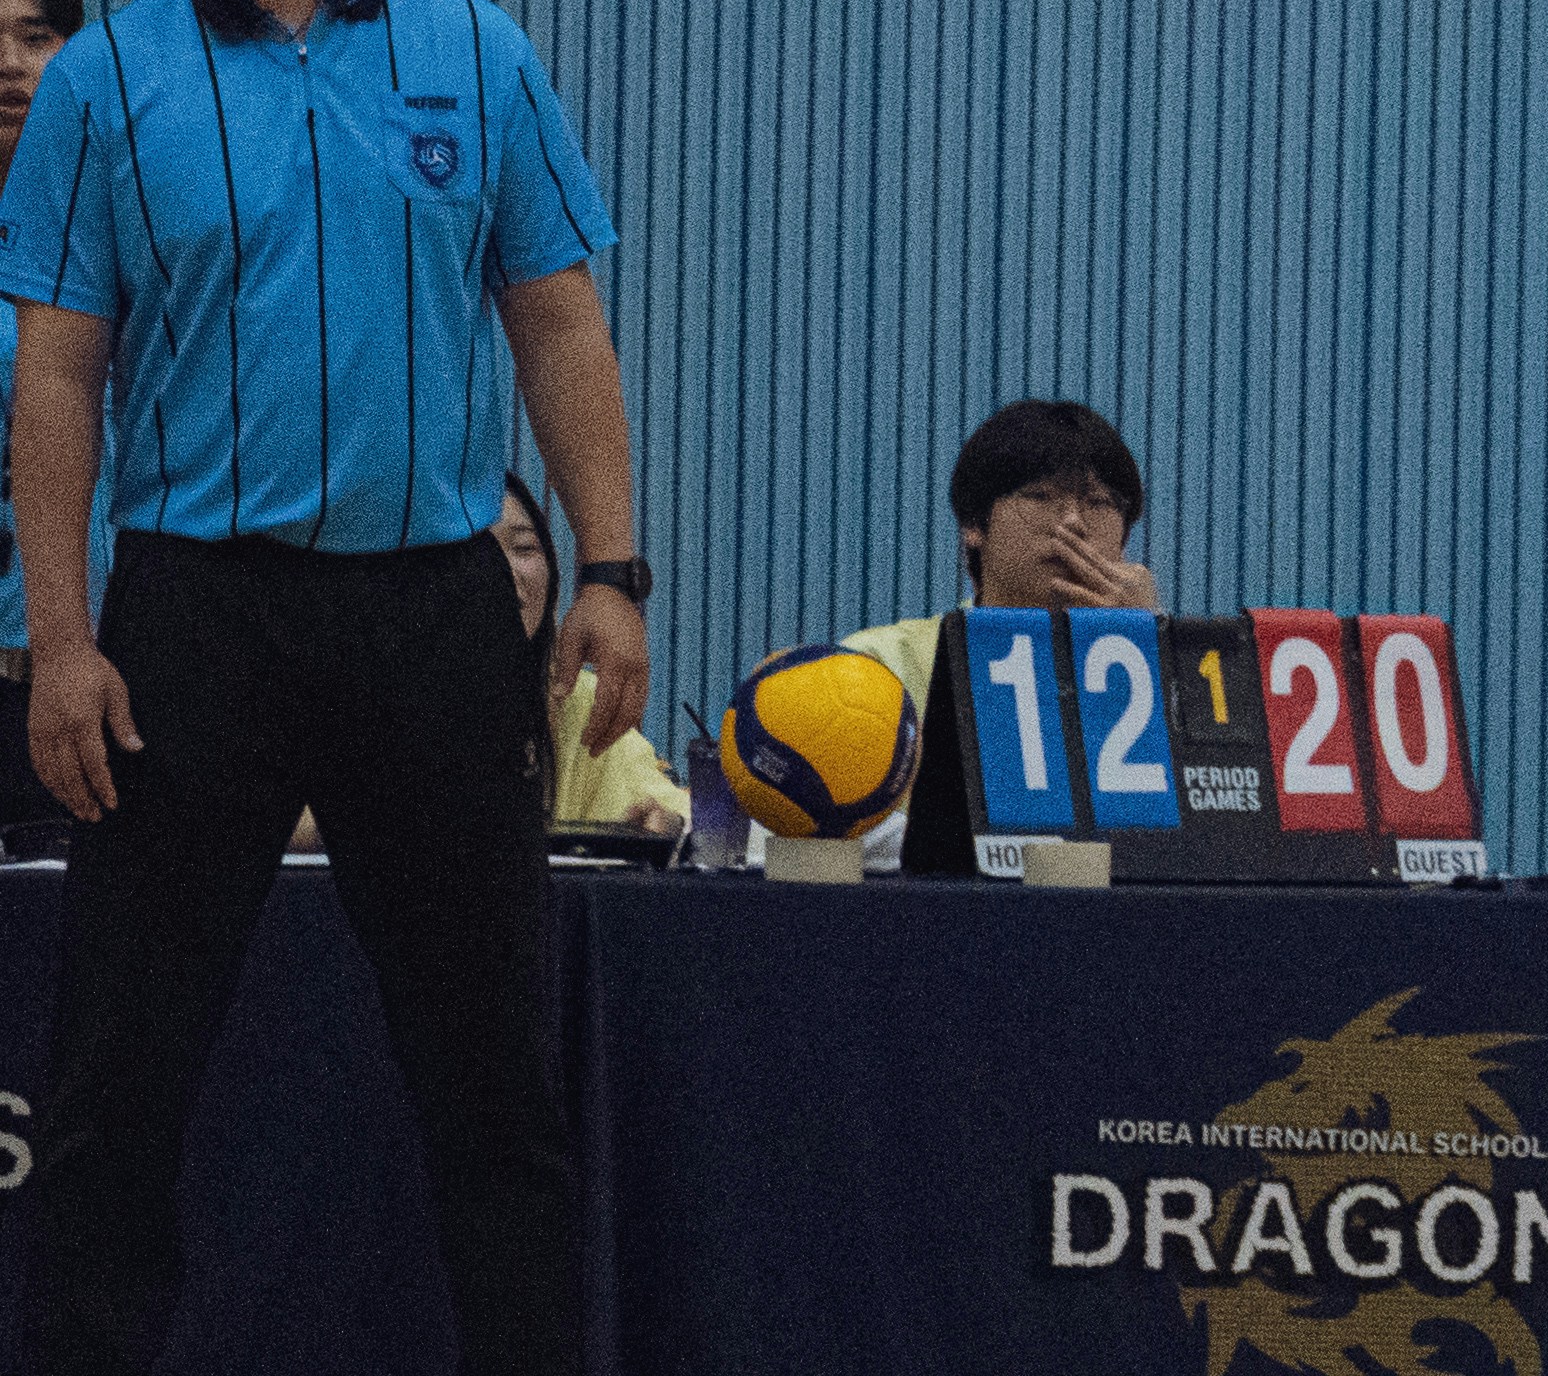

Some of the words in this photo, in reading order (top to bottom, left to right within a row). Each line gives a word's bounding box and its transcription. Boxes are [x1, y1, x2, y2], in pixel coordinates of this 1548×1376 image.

[1199, 650, 1229, 724] 1
[1183, 766, 1260, 789] PERIOD
[1188, 789, 1261, 812] GAMES
[985, 844, 1020, 868] HO
[1404, 850, 1478, 875] GUEST
[1098, 1119, 1194, 1145] KOREA
[1202, 1123, 1426, 1154] INTERNATIONAL
